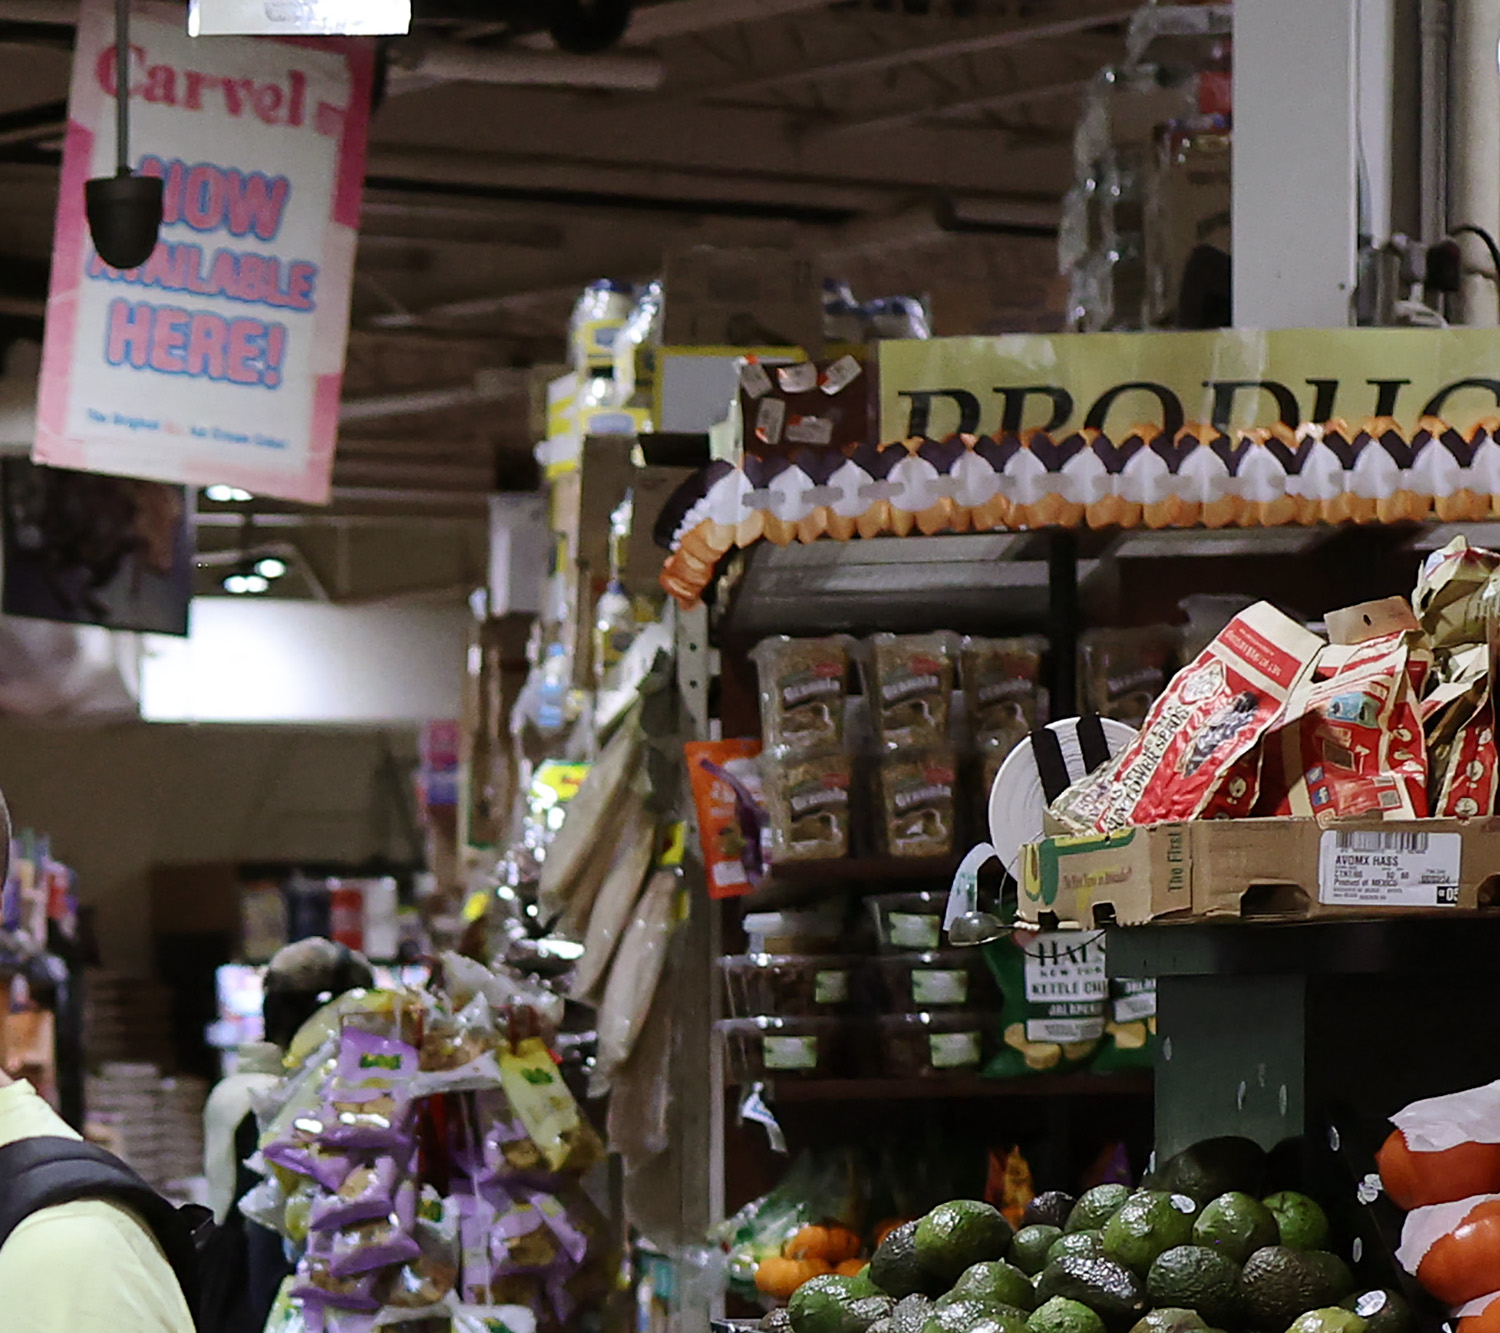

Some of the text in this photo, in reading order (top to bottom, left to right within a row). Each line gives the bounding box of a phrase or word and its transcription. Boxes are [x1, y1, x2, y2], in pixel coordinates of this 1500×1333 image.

[97, 44, 305, 128] Carvel
[137, 155, 291, 242] NOW
[105, 298, 287, 389] HERE!
[1167, 864, 1185, 893] The
[1372, 854, 1400, 867] HASS
